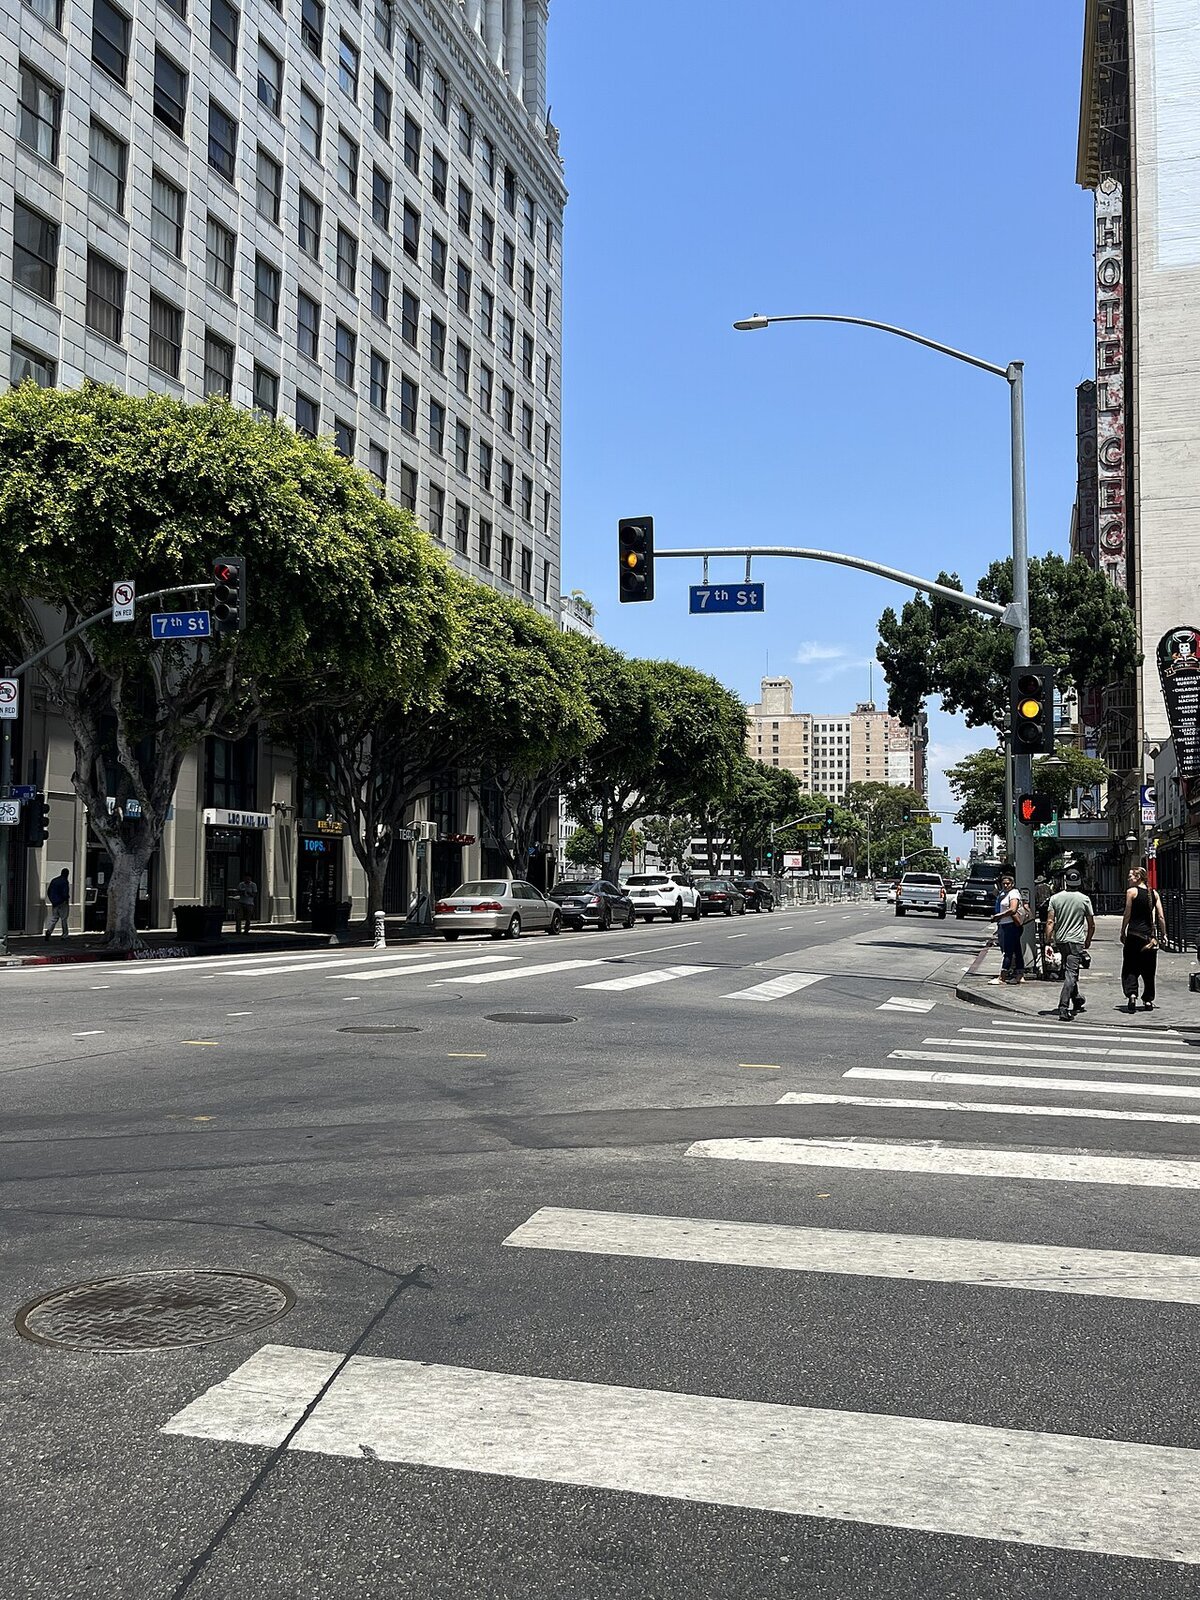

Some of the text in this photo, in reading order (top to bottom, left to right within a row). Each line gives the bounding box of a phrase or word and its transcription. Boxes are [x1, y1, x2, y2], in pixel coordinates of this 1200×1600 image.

[1097, 215, 1122, 589] HOTEL CECI
[697, 589, 757, 608] 7th St
[123, 608, 132, 617] RED
[157, 617, 204, 634] 7th St
[257, 815, 269, 829] BAR
